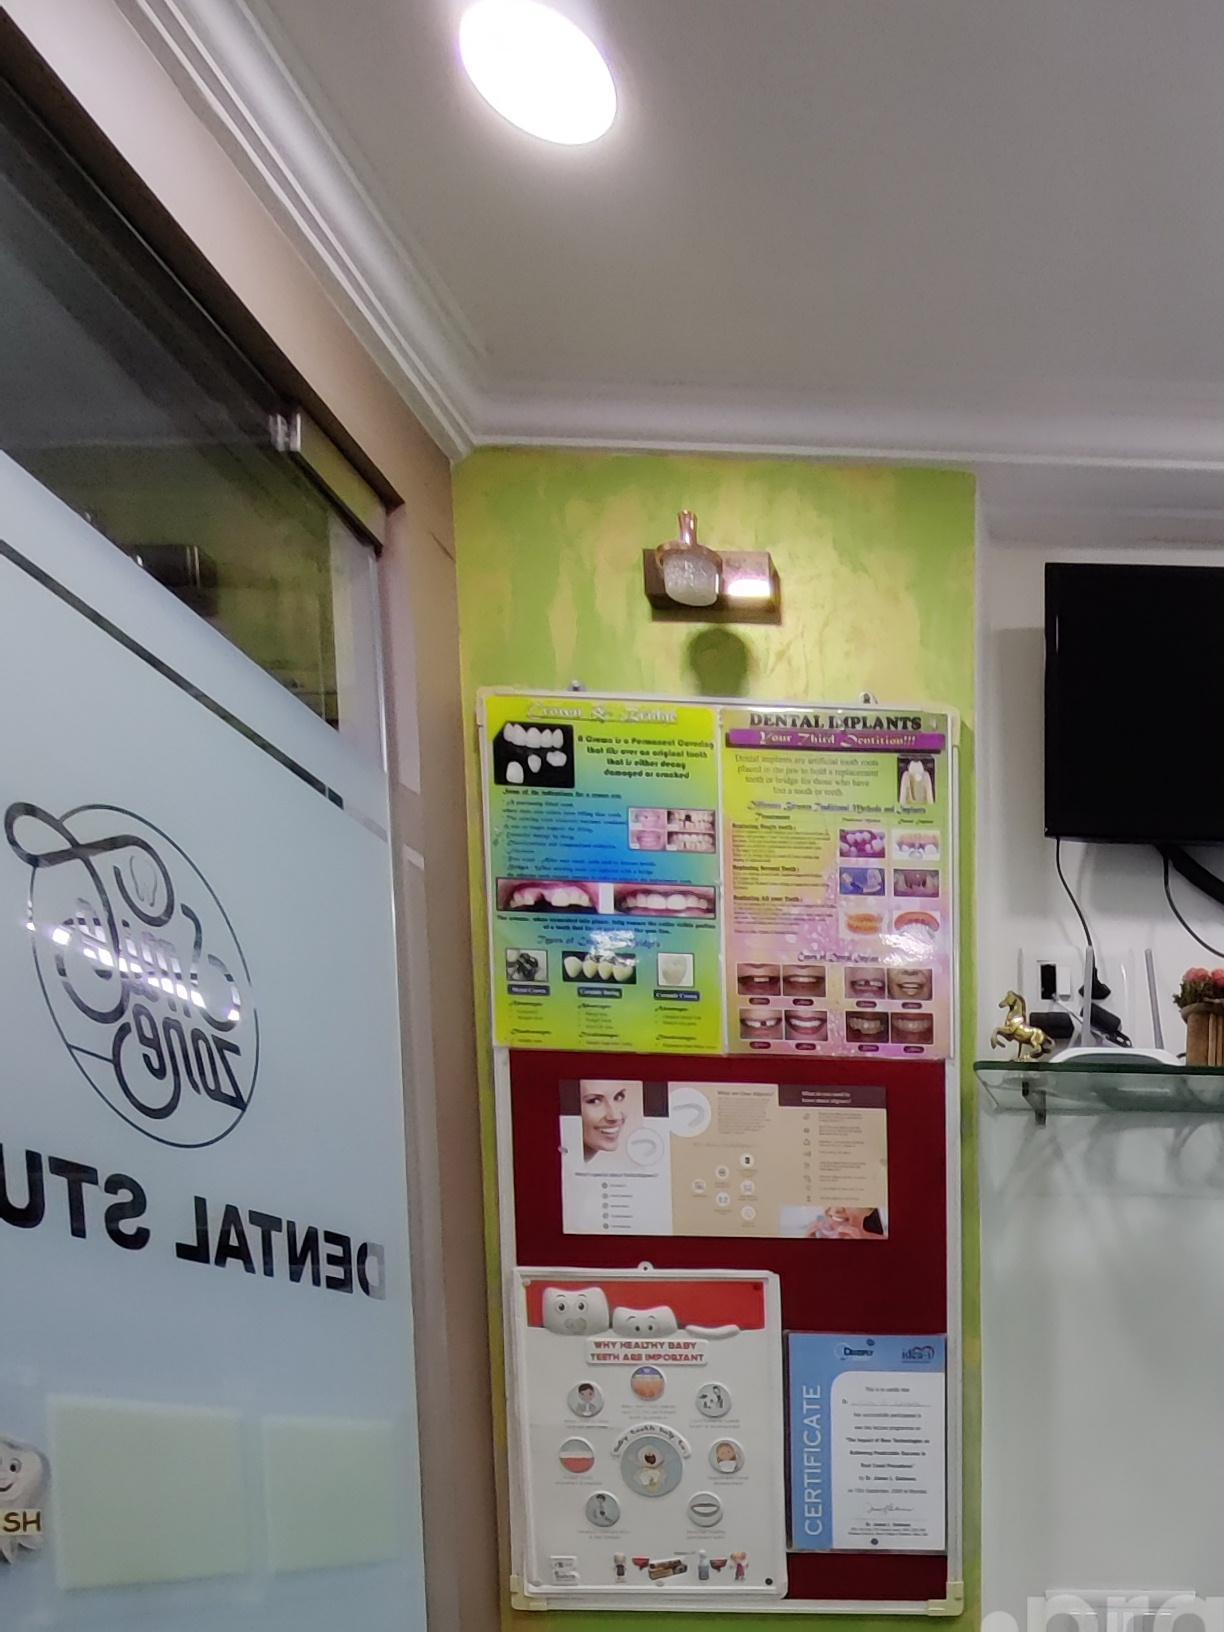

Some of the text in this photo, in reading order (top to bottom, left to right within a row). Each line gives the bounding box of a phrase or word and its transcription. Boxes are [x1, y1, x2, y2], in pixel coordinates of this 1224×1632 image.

[750, 713, 922, 730] DENTAL IMPLANTS
[593, 1341, 617, 1349] WHY
[620, 1341, 665, 1350] HEALTHY
[590, 1353, 619, 1361] TEETH
[803, 1385, 822, 1536] CERTIFICATE
